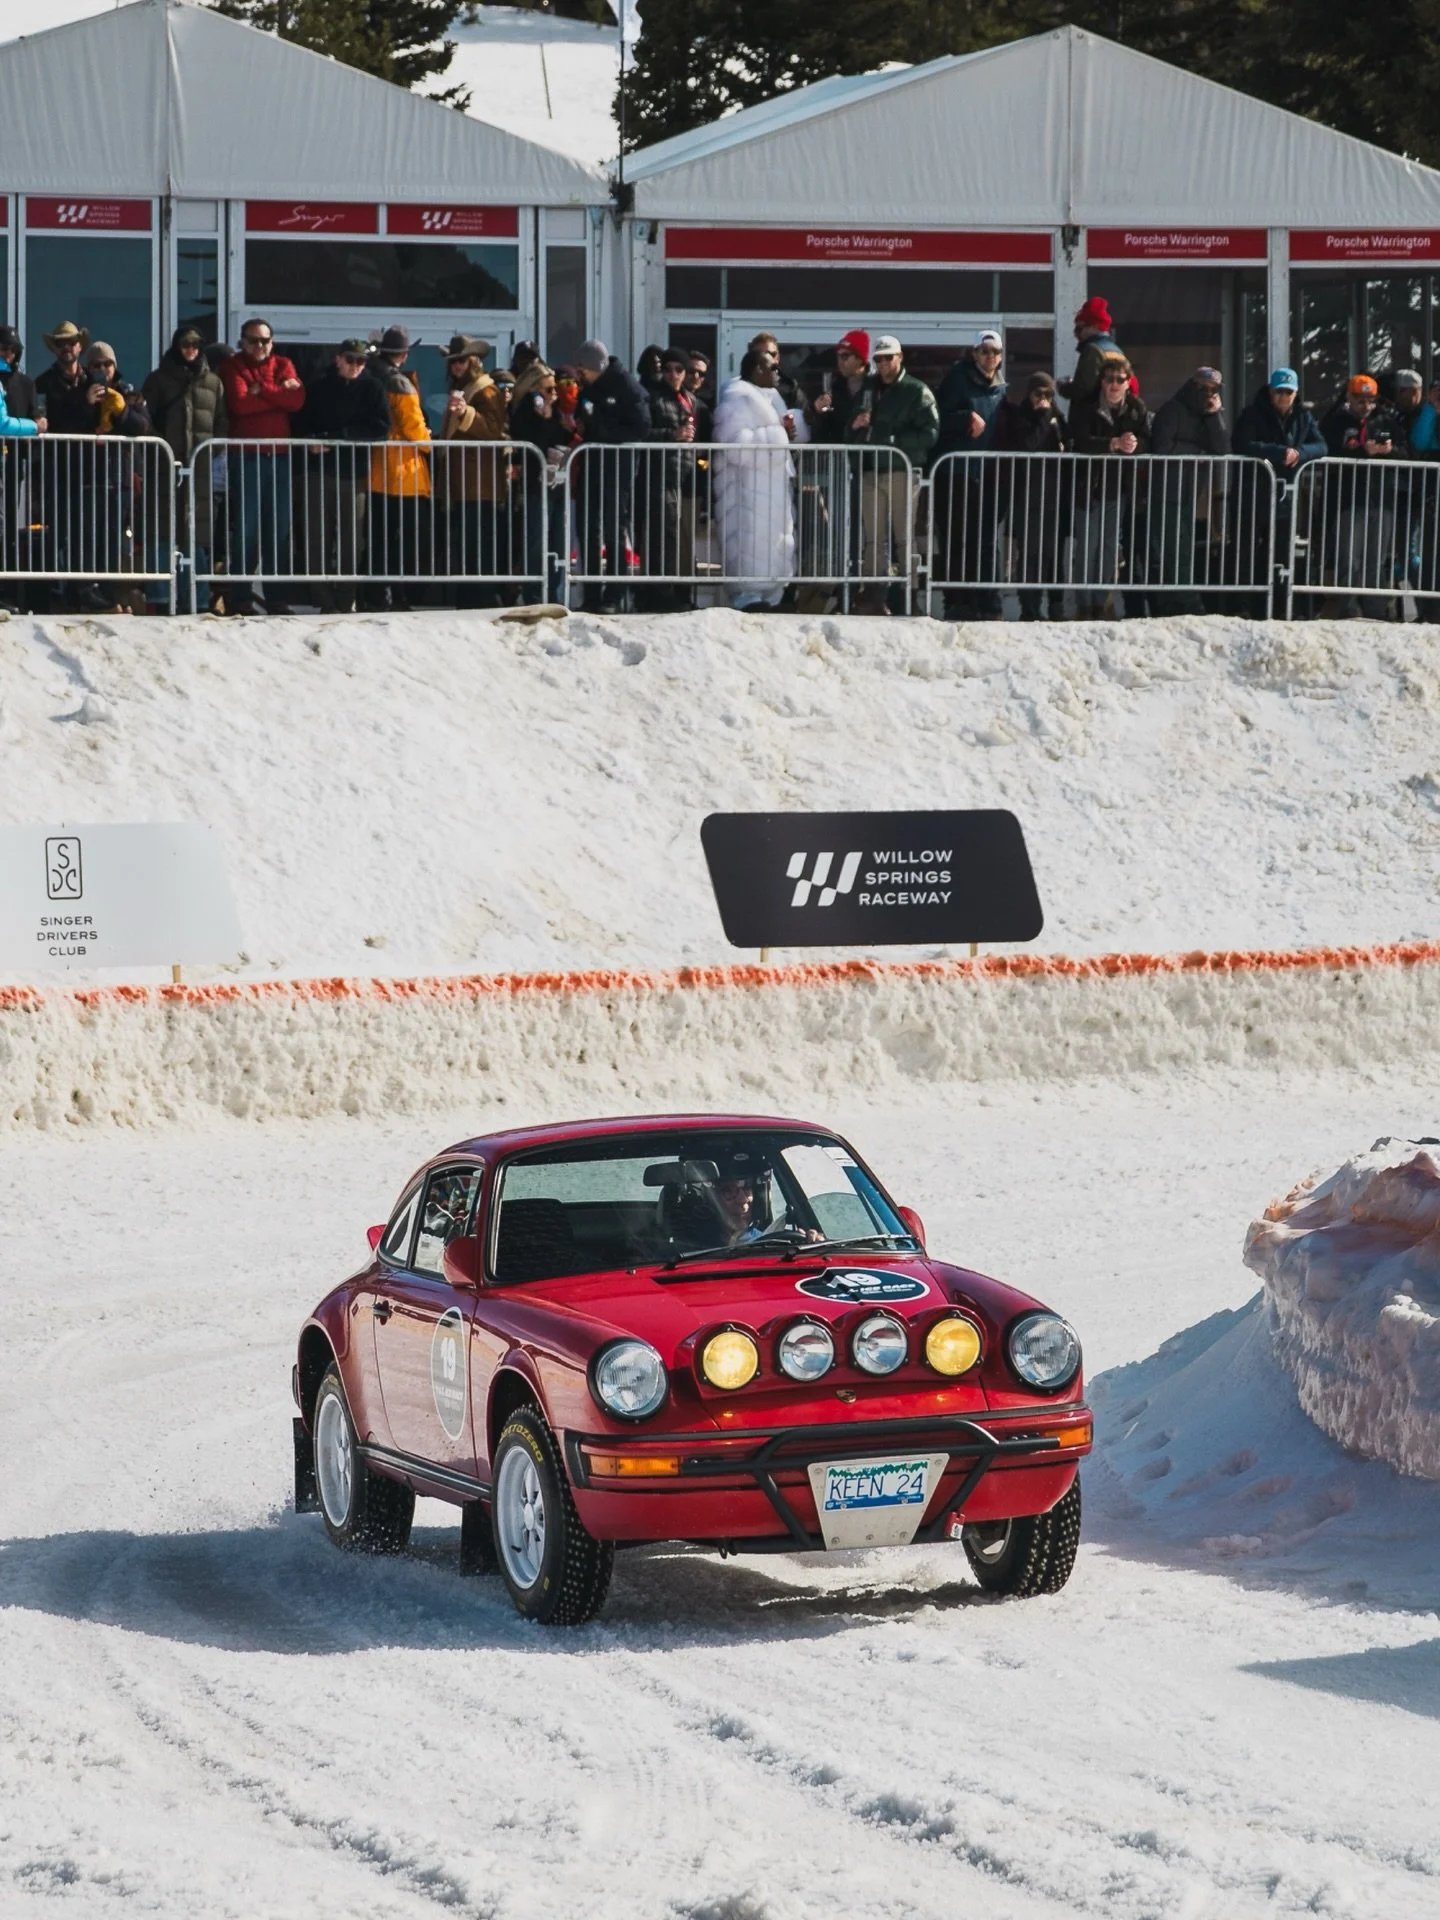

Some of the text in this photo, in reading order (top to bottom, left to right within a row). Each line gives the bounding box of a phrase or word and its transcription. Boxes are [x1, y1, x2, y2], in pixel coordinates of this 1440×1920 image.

[806, 234, 913, 250] Porsche Warrington
[1124, 233, 1230, 248] Porsche Warrington
[1326, 235, 1431, 250] Porsche Warrington
[873, 850, 953, 864] WILLOW
[865, 871, 952, 885] SPRINGS
[858, 891, 952, 906] RACEWAY
[40, 916, 93, 926] SINGER
[37, 931, 98, 941] DRIVERS
[49, 946, 87, 956] CLUB
[440, 1337, 456, 1381] 19
[830, 1472, 923, 1500] KEEN 24
